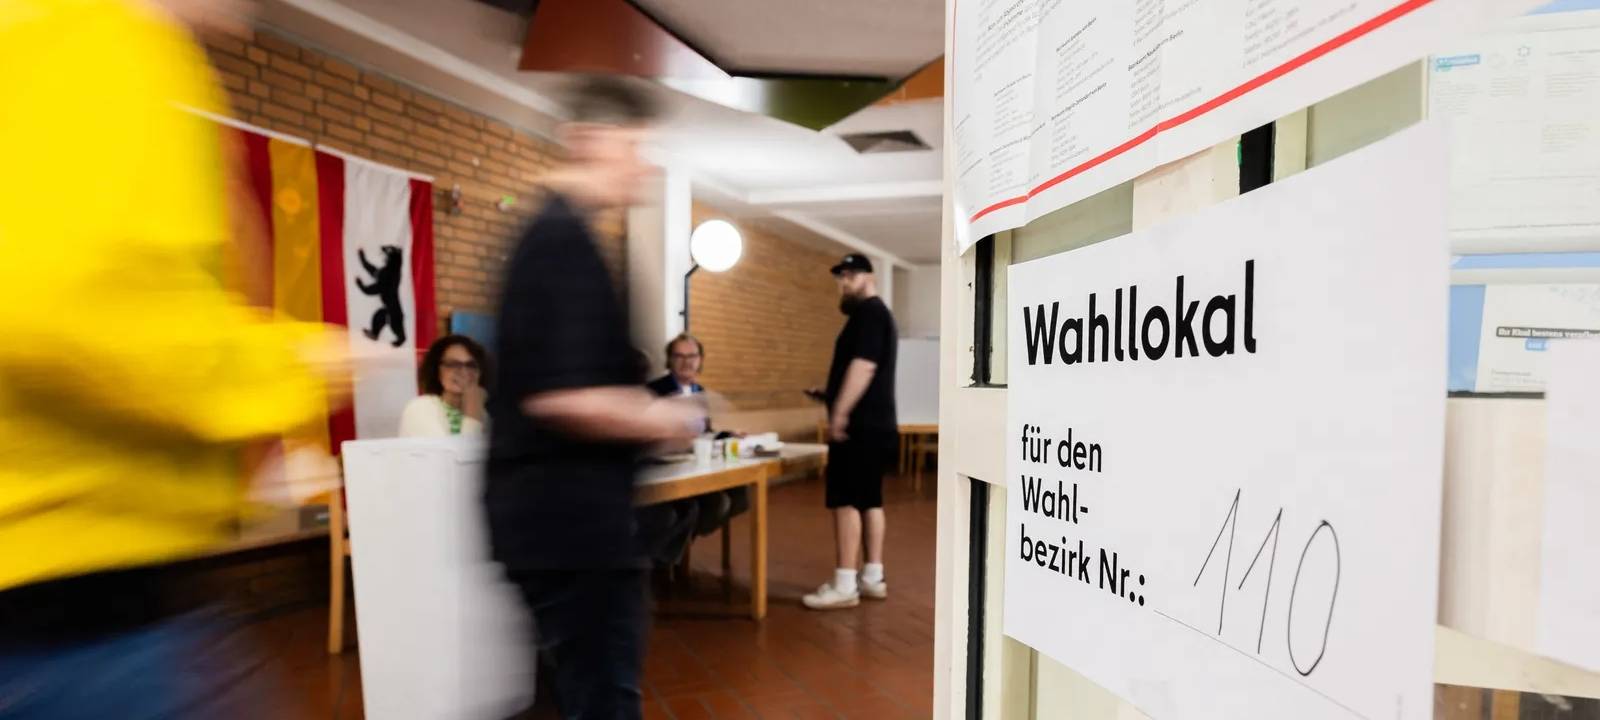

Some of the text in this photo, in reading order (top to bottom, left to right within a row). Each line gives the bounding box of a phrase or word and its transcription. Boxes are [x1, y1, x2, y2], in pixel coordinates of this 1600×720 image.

[1023, 259, 1257, 366] Wahllokal
[1021, 423, 1102, 473] für den
[1021, 474, 1089, 525] Wahl-
[1020, 523, 1145, 607] bezirk Nr.:
[1193, 488, 1341, 677] 110
